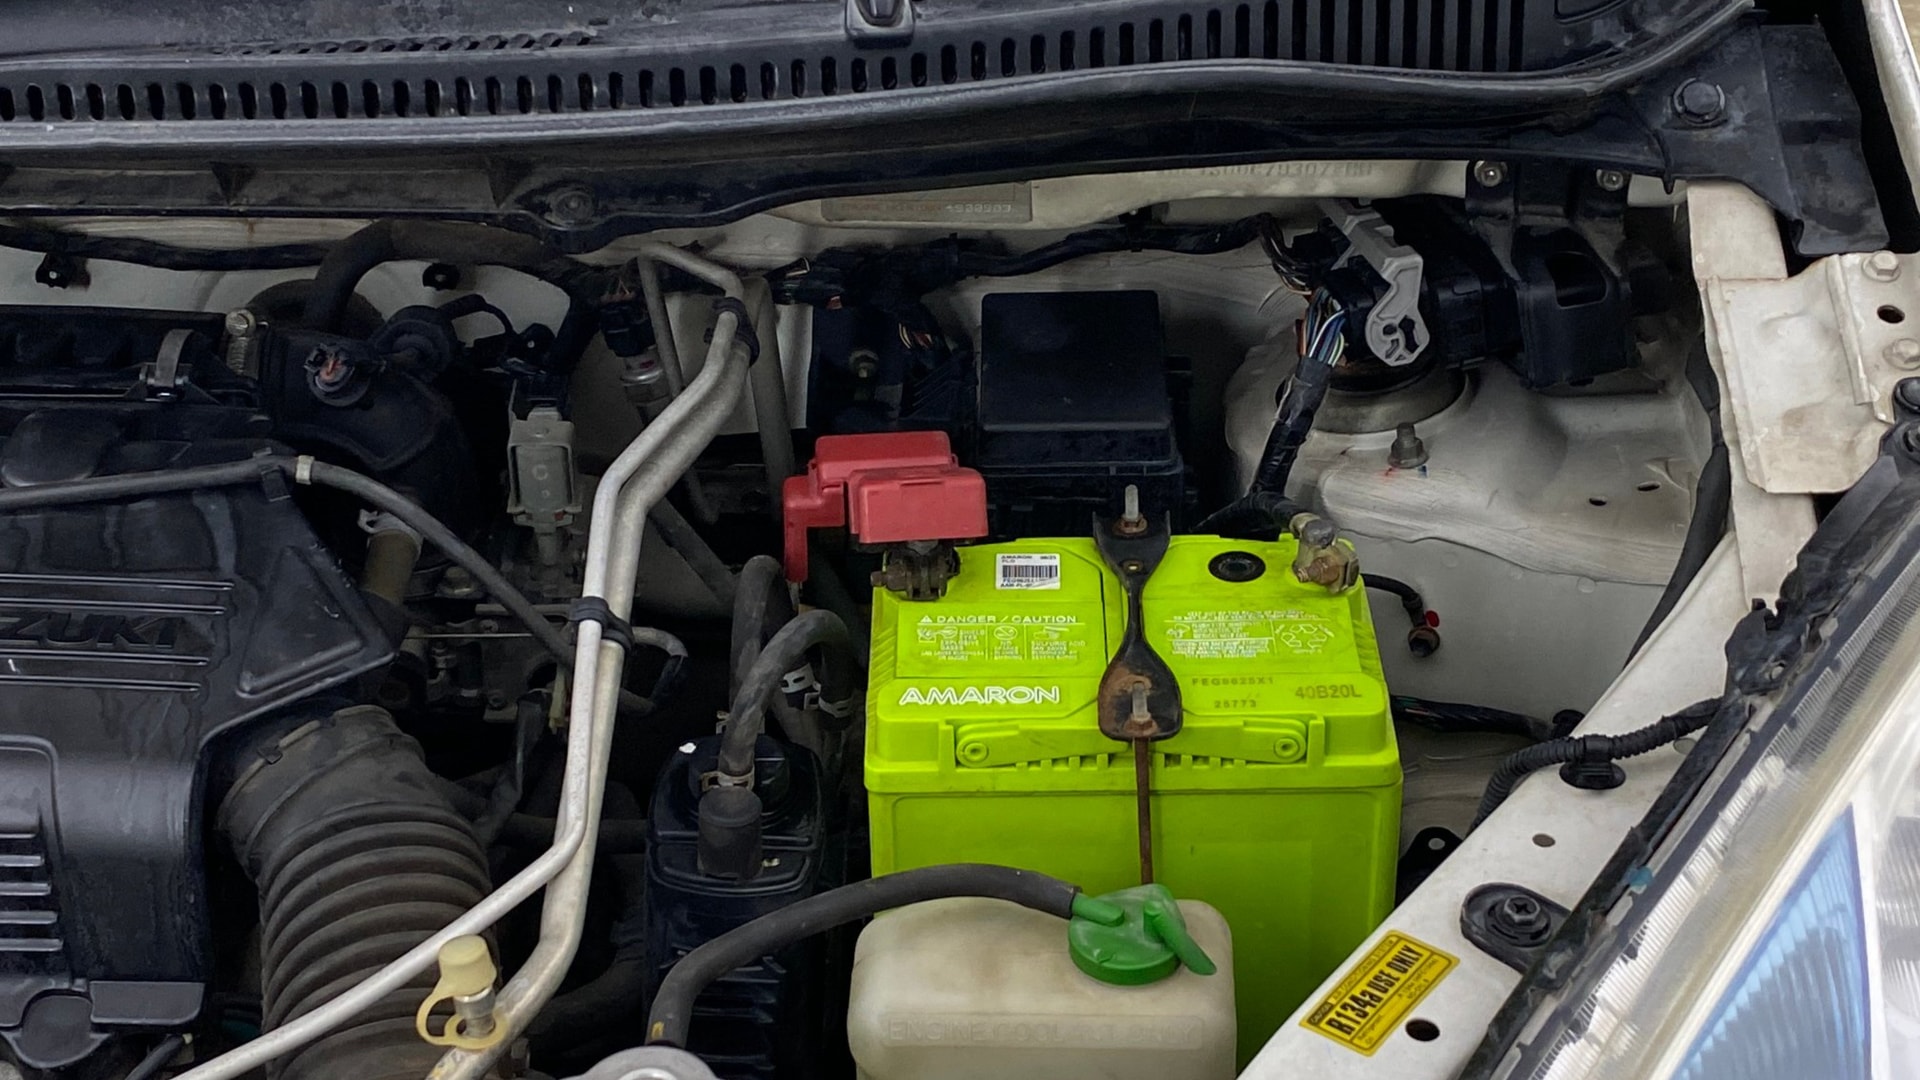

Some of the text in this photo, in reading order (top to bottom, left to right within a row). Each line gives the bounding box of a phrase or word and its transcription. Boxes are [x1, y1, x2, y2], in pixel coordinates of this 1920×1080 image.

[937, 615, 996, 623] DANGER
[1012, 615, 1076, 623] CAUTION
[898, 686, 1060, 705] AMARON
[1295, 684, 1363, 699] 40B20L
[1325, 990, 1383, 1035] R134a
[1367, 969, 1400, 994] USE
[1386, 944, 1424, 974] ONLY
